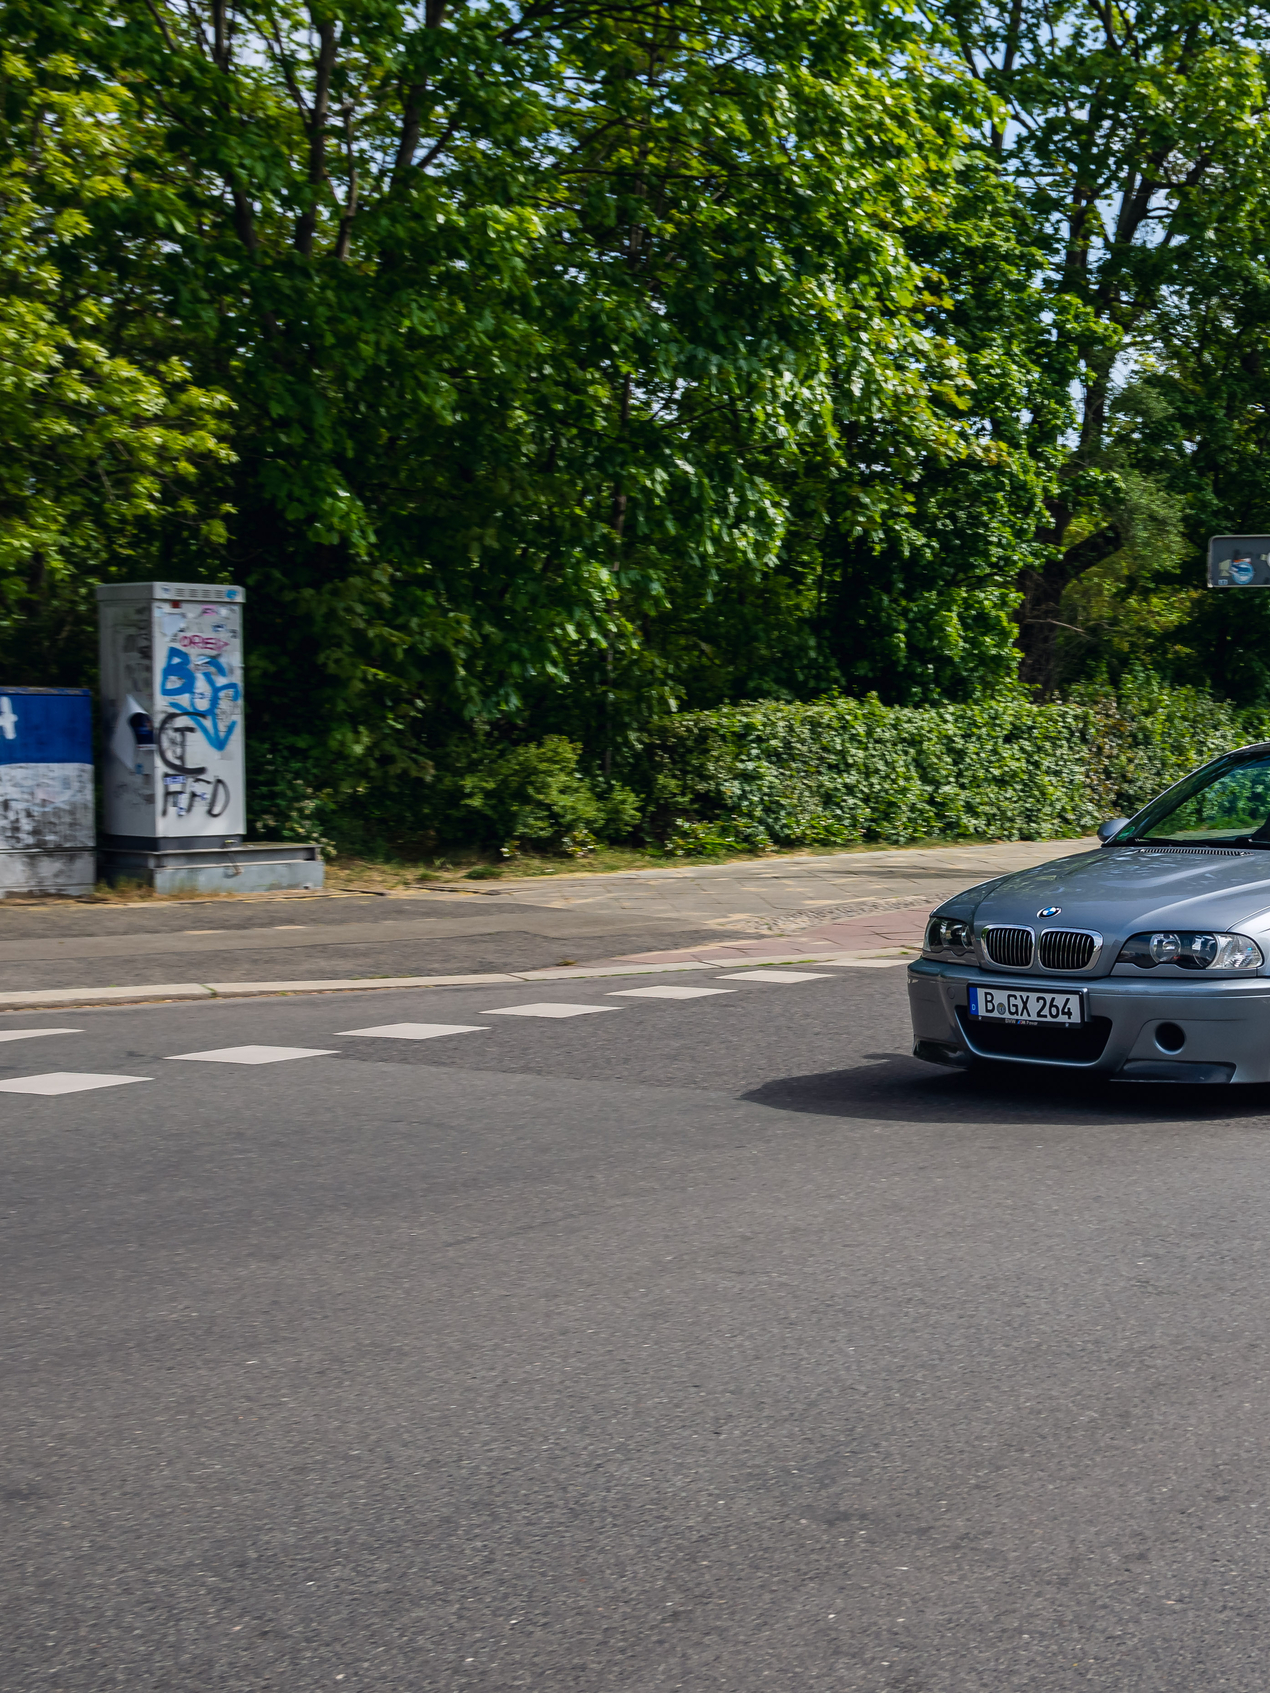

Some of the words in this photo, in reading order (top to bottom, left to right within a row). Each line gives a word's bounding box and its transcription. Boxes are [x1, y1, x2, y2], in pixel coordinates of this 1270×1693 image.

[984, 991, 996, 1014] B
[1006, 994, 1032, 1018] GX
[1035, 996, 1073, 1020] 264
